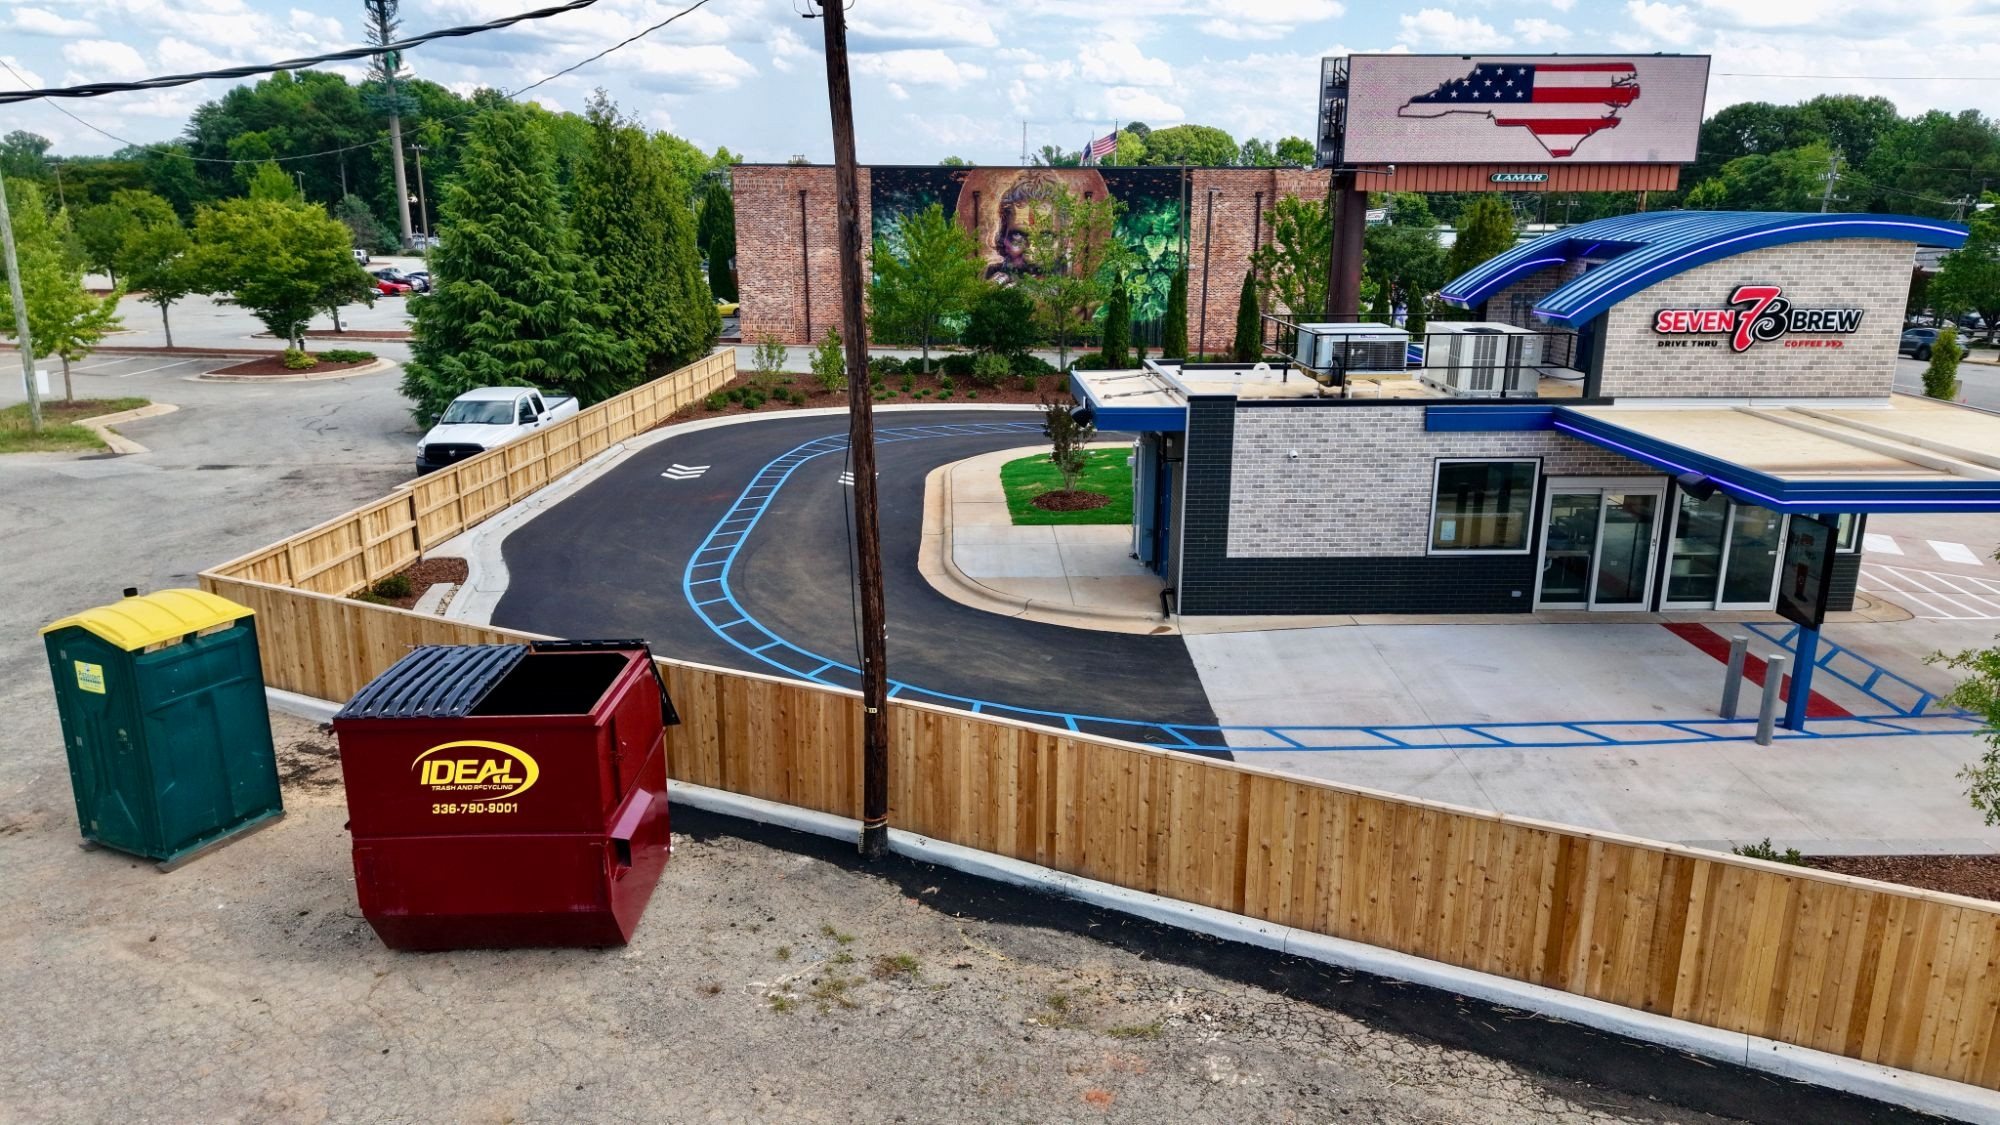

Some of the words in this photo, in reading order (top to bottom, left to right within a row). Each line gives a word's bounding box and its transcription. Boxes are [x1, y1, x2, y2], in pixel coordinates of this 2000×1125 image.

[1496, 173, 1542, 181] LAMAR
[1656, 309, 1735, 332] SEVEN
[1790, 309, 1862, 332] BREW
[1658, 340, 1687, 348] DRIVE
[1692, 340, 1718, 348] THRU
[1785, 339, 1822, 348] COFFEE
[421, 759, 522, 785] IDEAL
